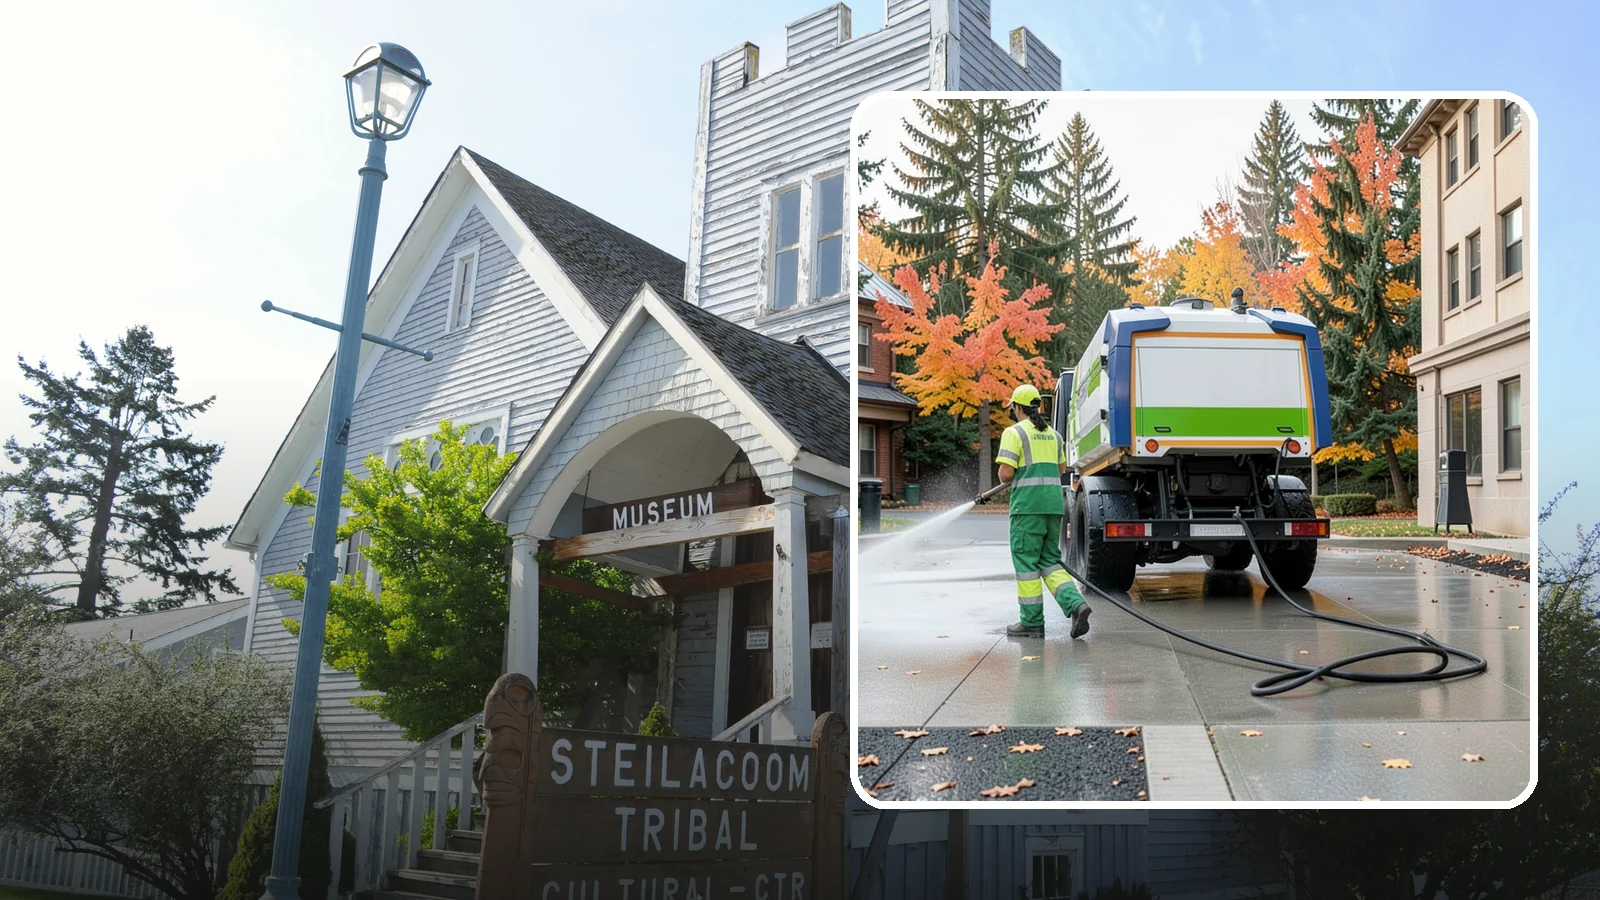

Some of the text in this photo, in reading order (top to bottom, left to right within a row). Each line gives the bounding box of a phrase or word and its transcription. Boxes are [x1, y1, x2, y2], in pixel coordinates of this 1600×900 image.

[612, 491, 714, 531] MUSEUM
[550, 738, 810, 793] STEILACOOM
[615, 806, 758, 852] TRIBAL
